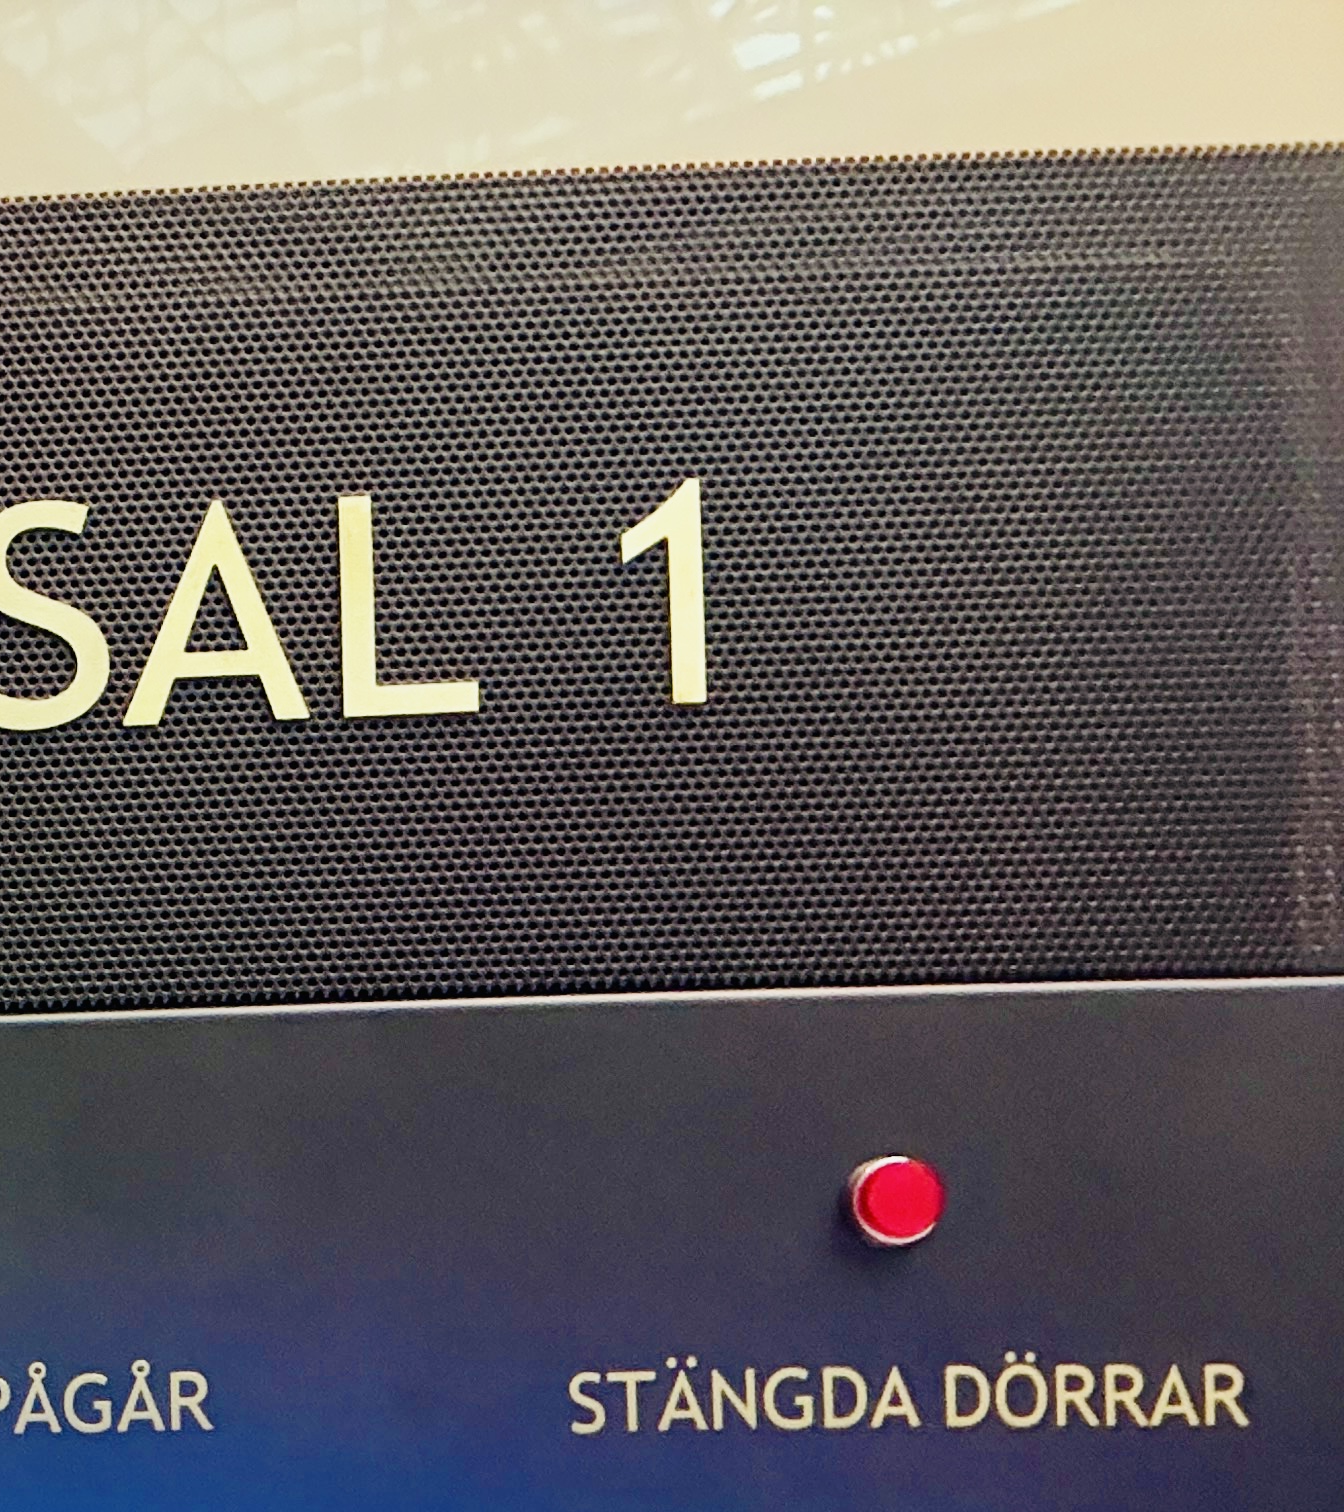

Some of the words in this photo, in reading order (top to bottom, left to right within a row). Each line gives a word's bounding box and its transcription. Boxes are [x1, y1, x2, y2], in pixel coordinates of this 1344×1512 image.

[619, 476, 710, 706] 1
[568, 1355, 921, 1435] STÄNGDA
[944, 1351, 1250, 1428] DÖRRAR
